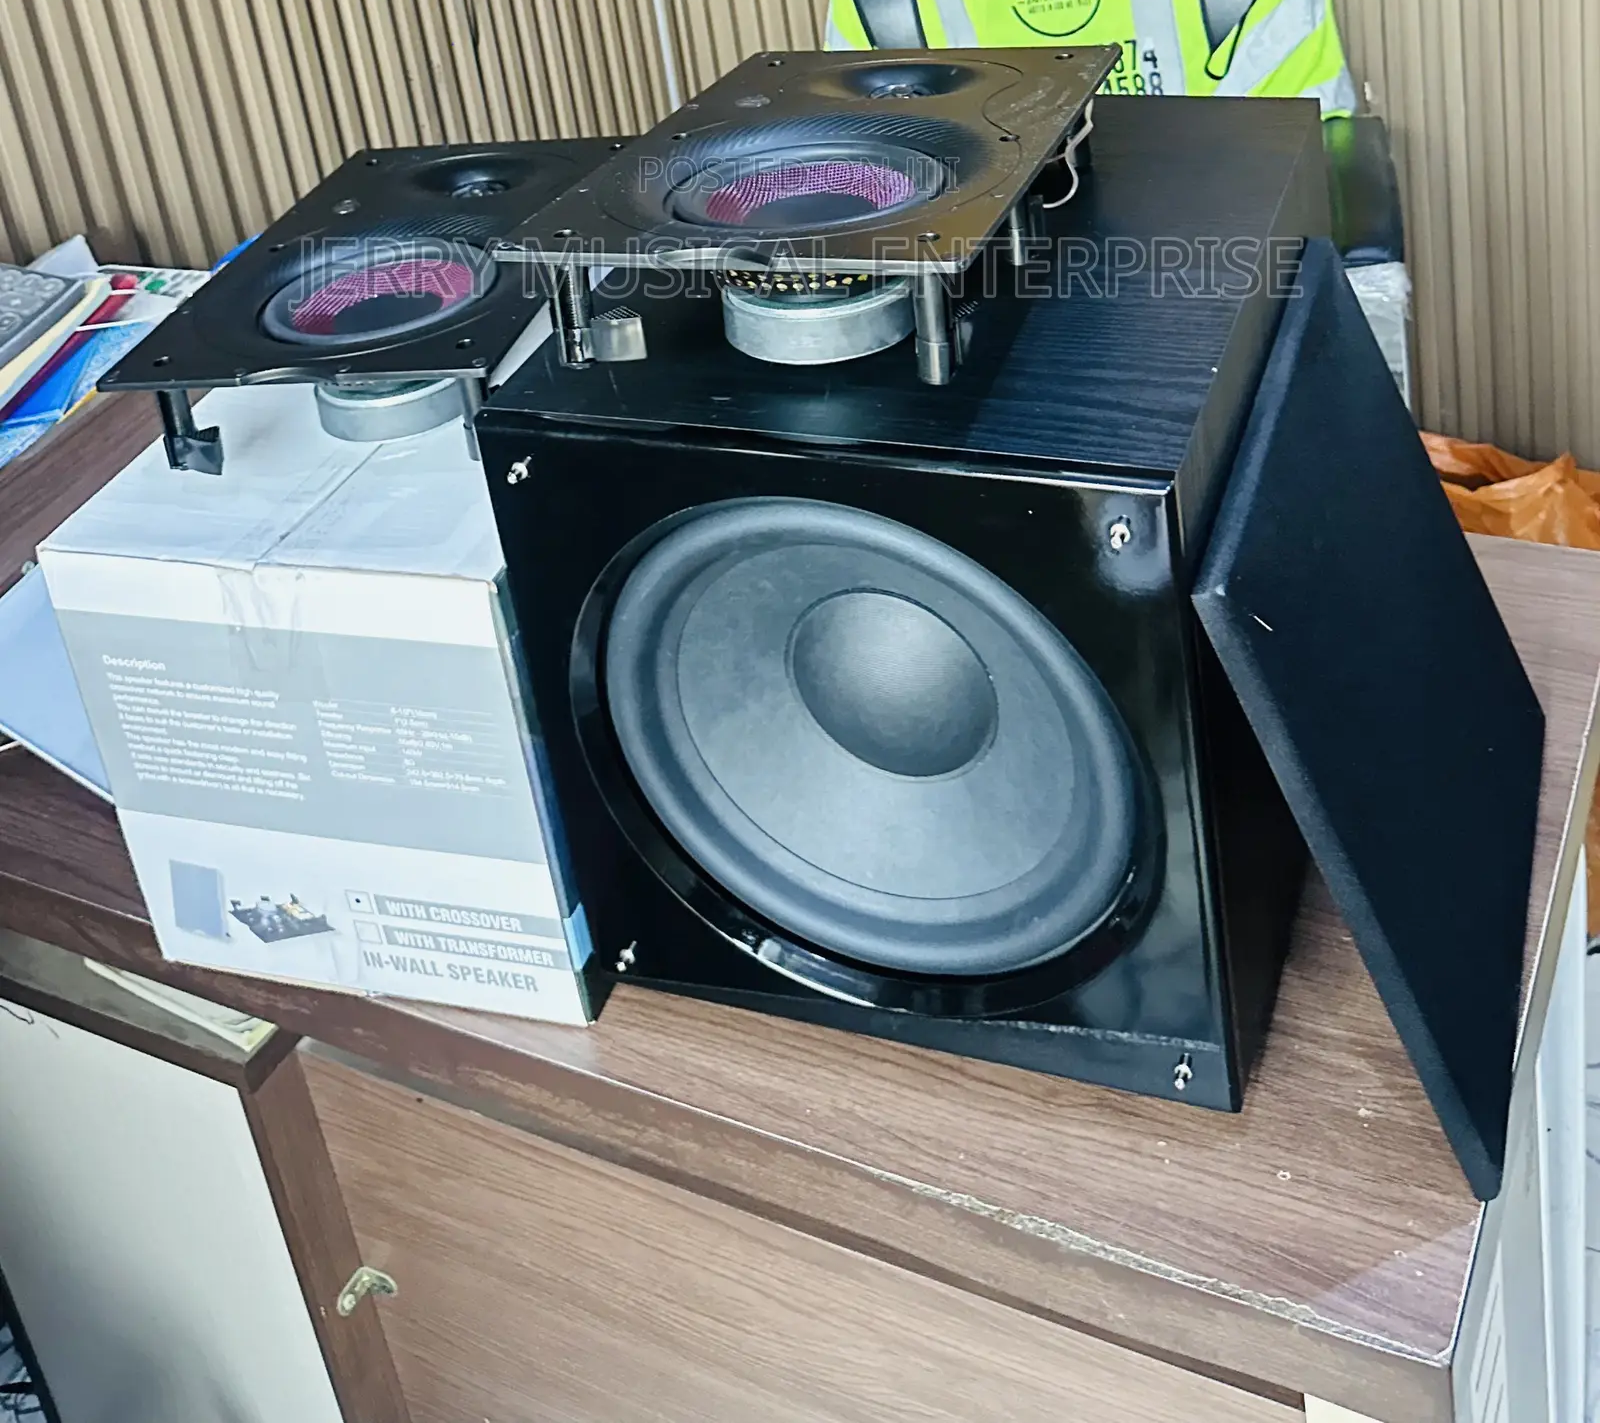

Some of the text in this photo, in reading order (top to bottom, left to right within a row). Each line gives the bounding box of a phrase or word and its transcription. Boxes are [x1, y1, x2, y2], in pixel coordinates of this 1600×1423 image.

[102, 654, 166, 671] Description
[385, 900, 523, 932] WITH CROSSOVER
[394, 931, 555, 967] WITH TRANSFORMER
[363, 950, 540, 993] IN-WALL SPEAKER
